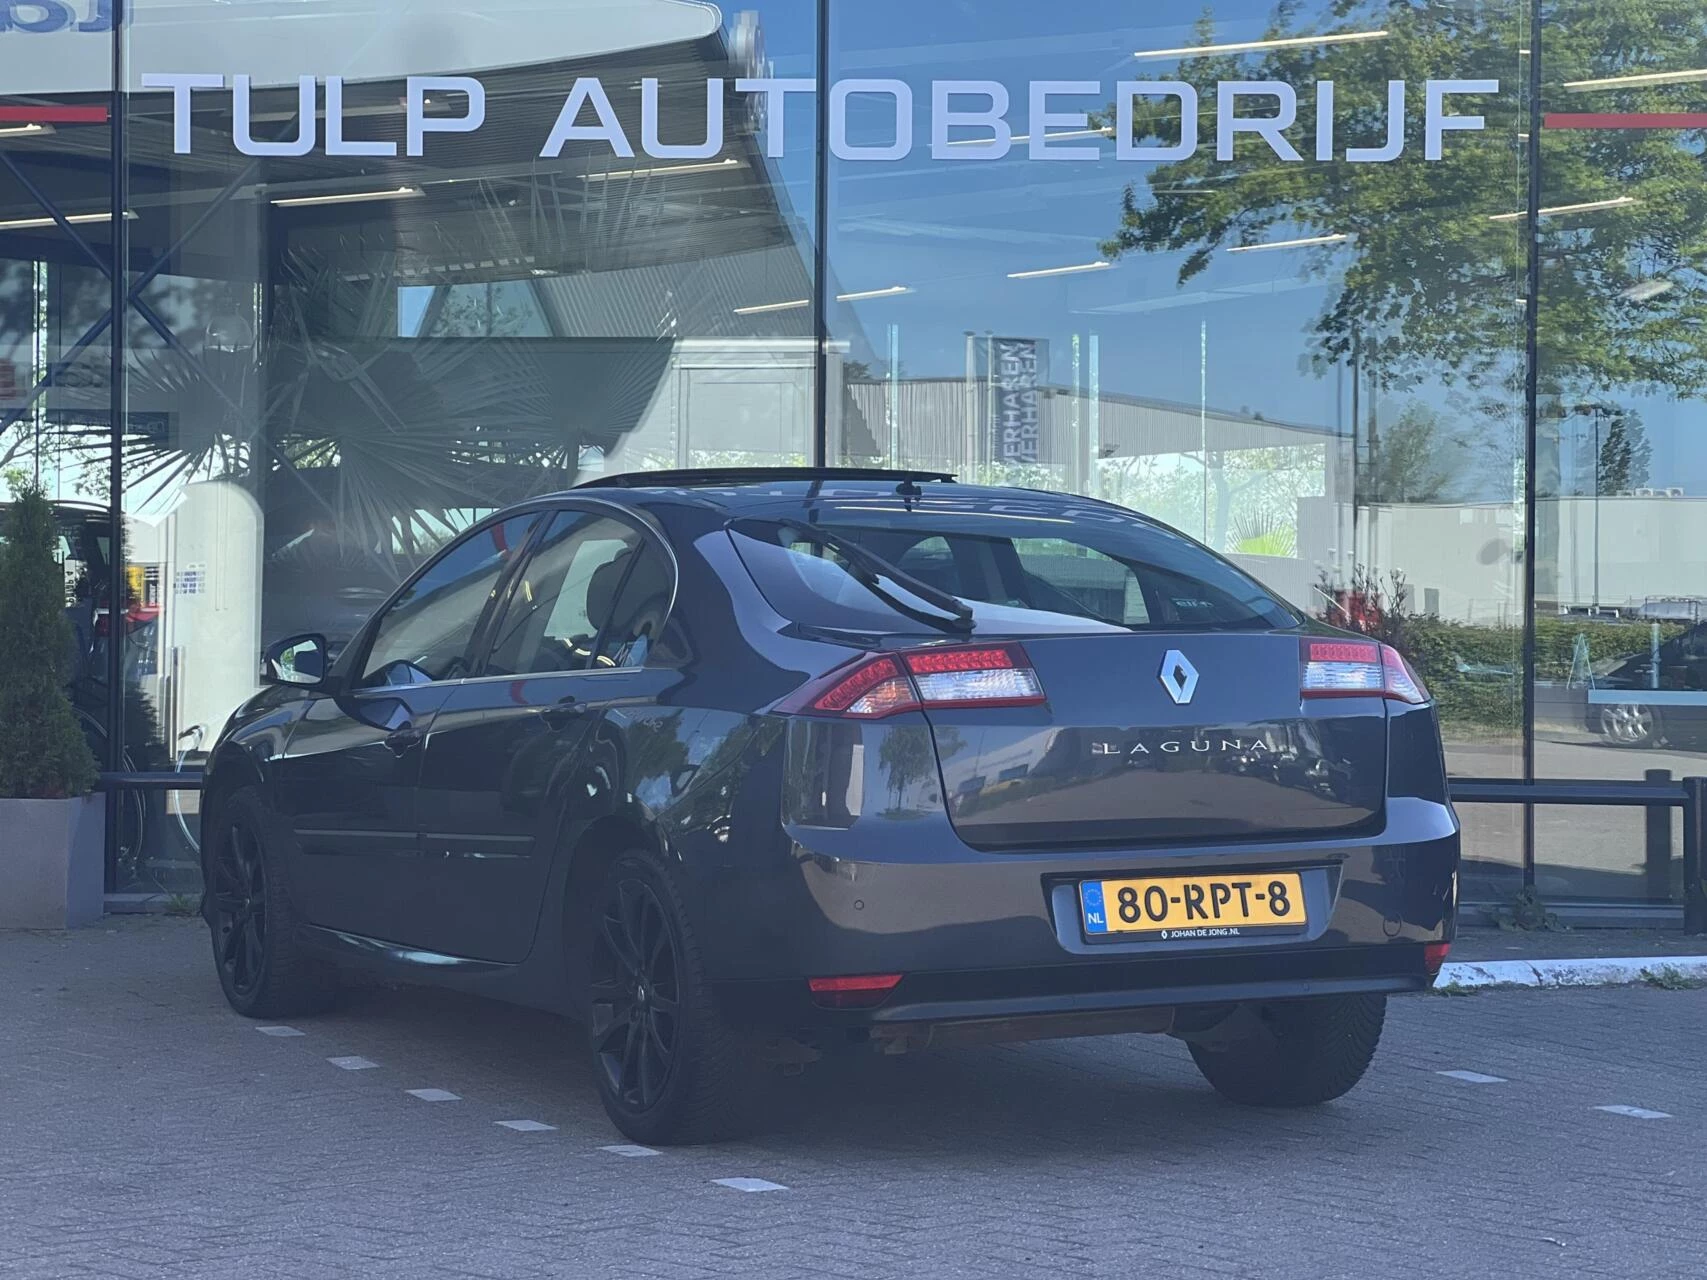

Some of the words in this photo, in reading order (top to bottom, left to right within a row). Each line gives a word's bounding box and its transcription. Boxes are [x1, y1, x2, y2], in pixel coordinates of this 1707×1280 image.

[141, 73, 485, 156] TULP
[538, 77, 1499, 162] AUTOBEDRIJF
[1103, 739, 1268, 754] LAGUNA
[1117, 881, 1291, 923] 80-RPT-8
[1088, 912, 1104, 924] NL
[1170, 929, 1196, 938] JOHAN
[1197, 929, 1207, 937] DE
[1208, 928, 1228, 936] JONG
